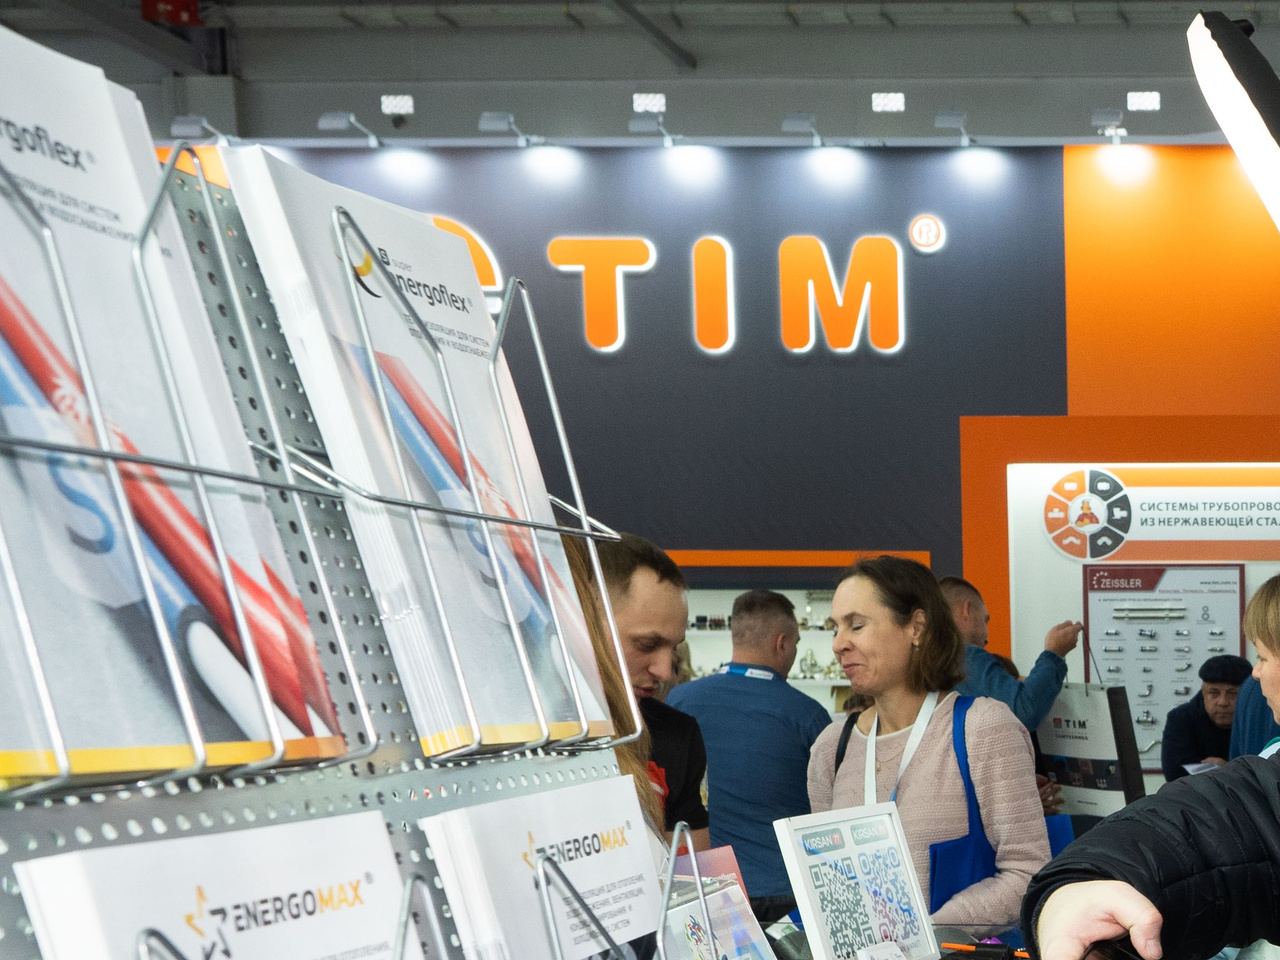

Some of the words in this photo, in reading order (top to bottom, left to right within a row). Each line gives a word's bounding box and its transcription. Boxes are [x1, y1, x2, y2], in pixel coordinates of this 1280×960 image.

[394, 272, 470, 314] nergoflex
[1139, 501, 1199, 511] СИСТЕМЫ
[1139, 517, 1156, 527] ИЗ
[1158, 515, 1254, 528] НЕРЖАВЕЮЩЕЙ
[1100, 578, 1142, 589] ZEISSLER
[1064, 719, 1087, 729] TIM
[804, 839, 833, 851] KIRSAN
[232, 879, 364, 932] ENERGOMAX
